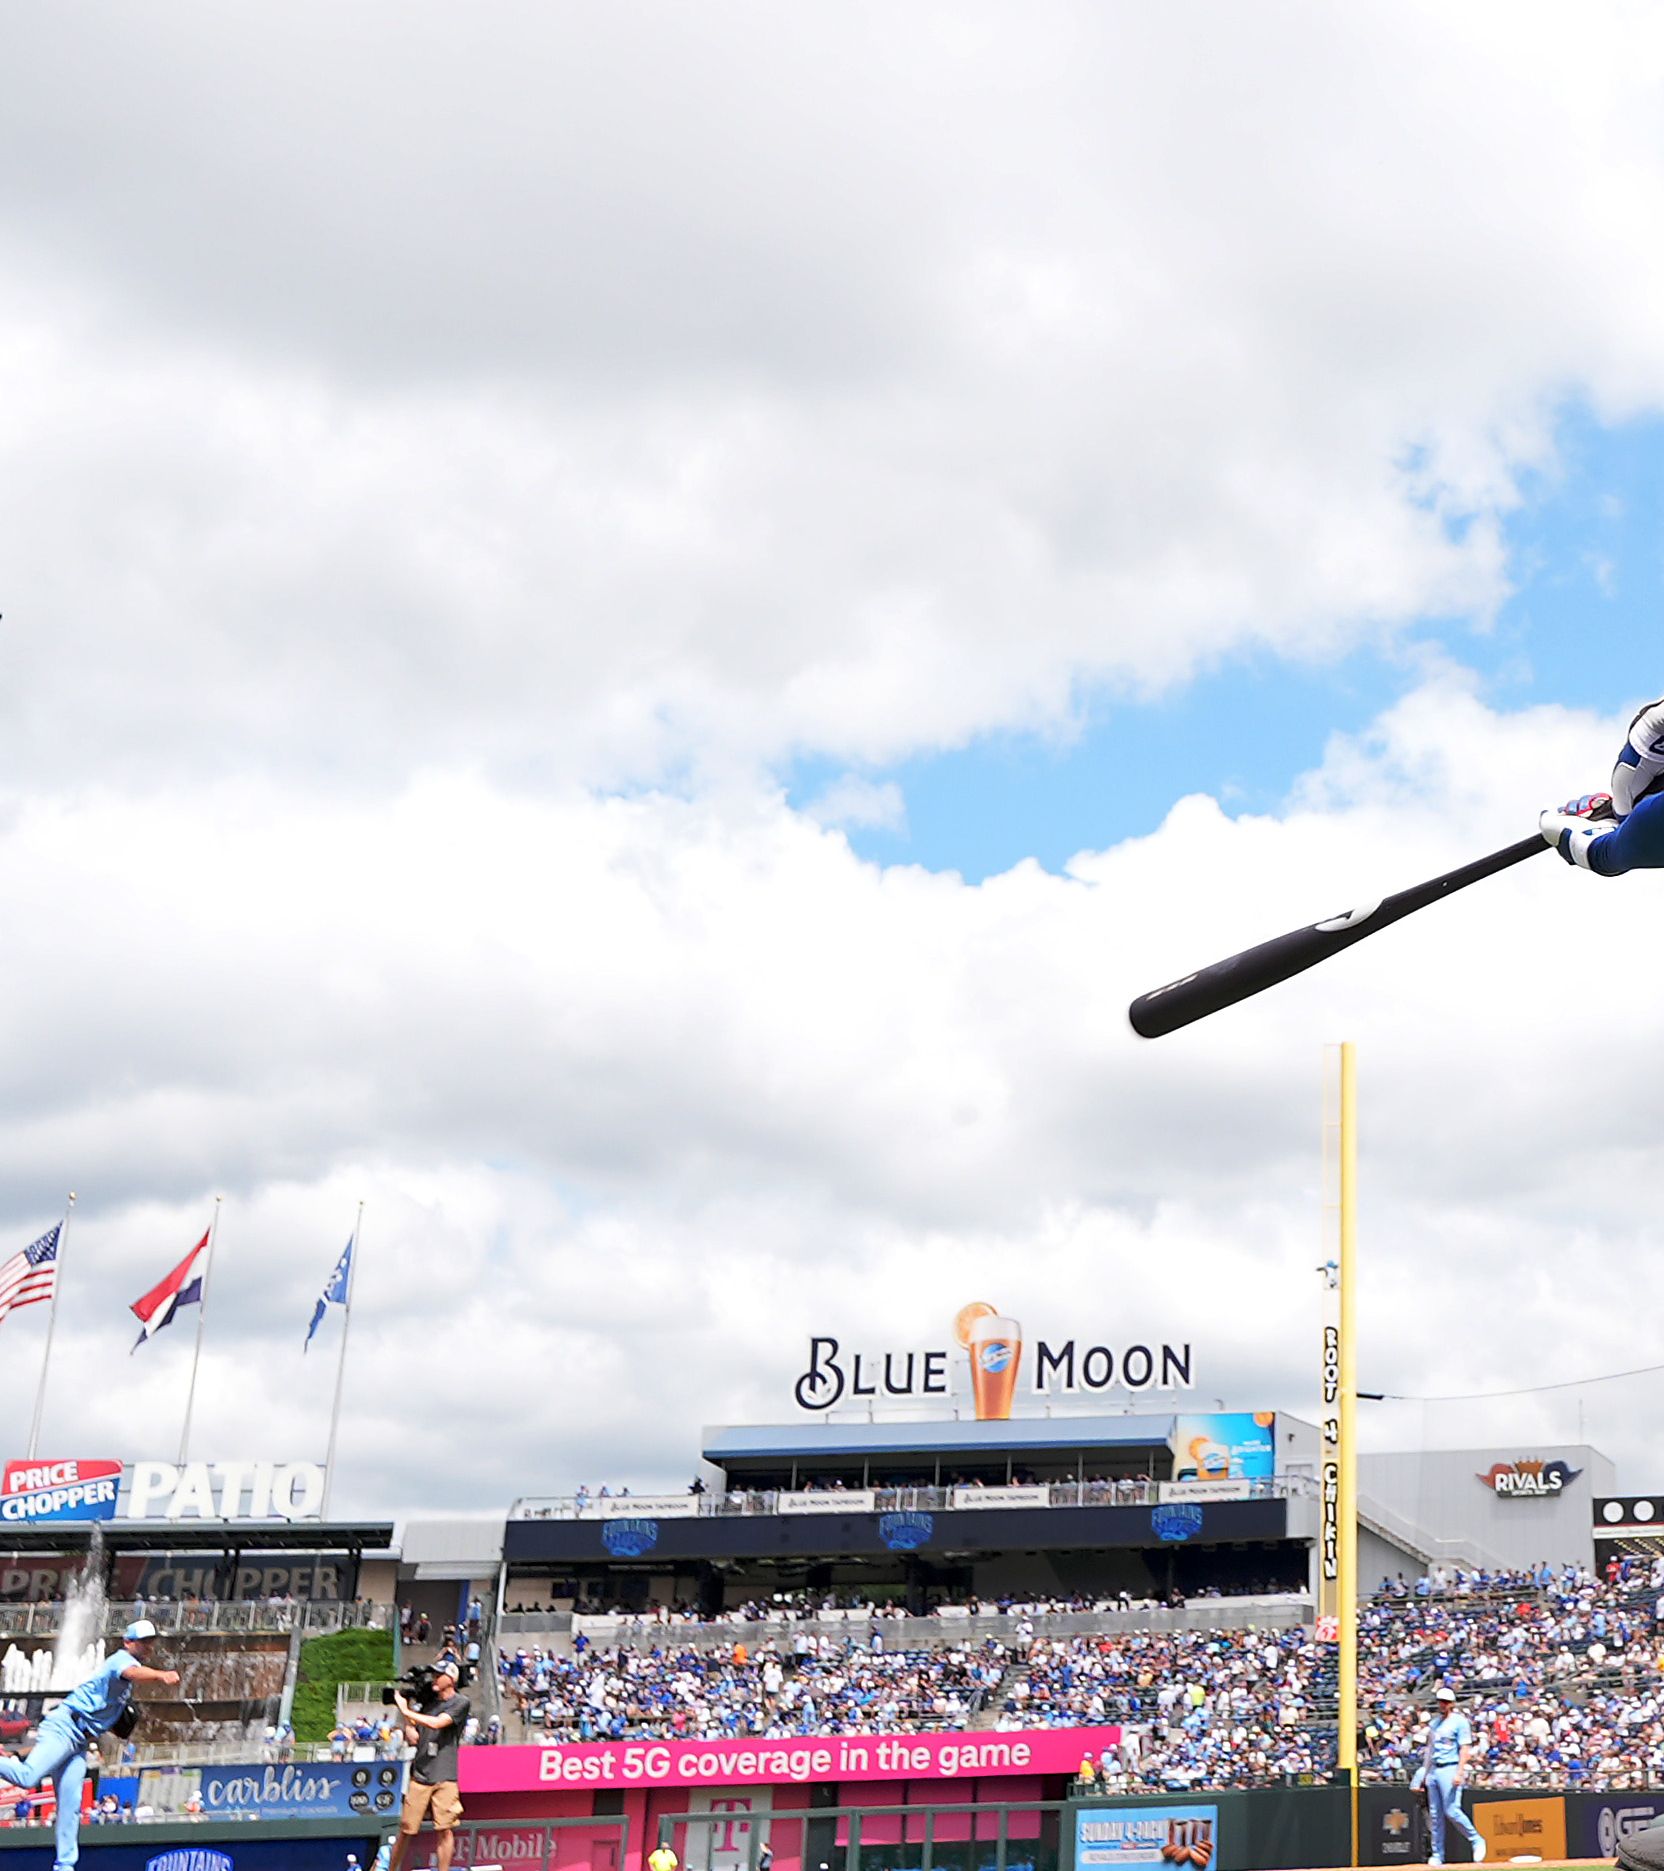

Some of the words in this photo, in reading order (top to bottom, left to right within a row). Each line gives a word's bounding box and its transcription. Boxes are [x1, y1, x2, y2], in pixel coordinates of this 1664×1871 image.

[796, 1337, 947, 1410] BLUE
[1037, 1340, 1191, 1390] MOON
[1323, 1327, 1338, 1403] ROOT
[1324, 1420, 1338, 1445] 4
[10, 1461, 80, 1492] PRICE
[127, 1461, 324, 1519] PATIO
[1495, 1470, 1563, 1492] RIVALS
[2, 1479, 116, 1521] CHOPPER
[1323, 1463, 1338, 1581] CHIKIN
[539, 1750, 616, 1781] Best
[622, 1747, 670, 1779] 5G
[678, 1747, 831, 1783] coverage
[839, 1741, 868, 1771] in
[875, 1740, 931, 1771] the
[939, 1743, 1031, 1778] game
[208, 1765, 341, 1806] carbliss
